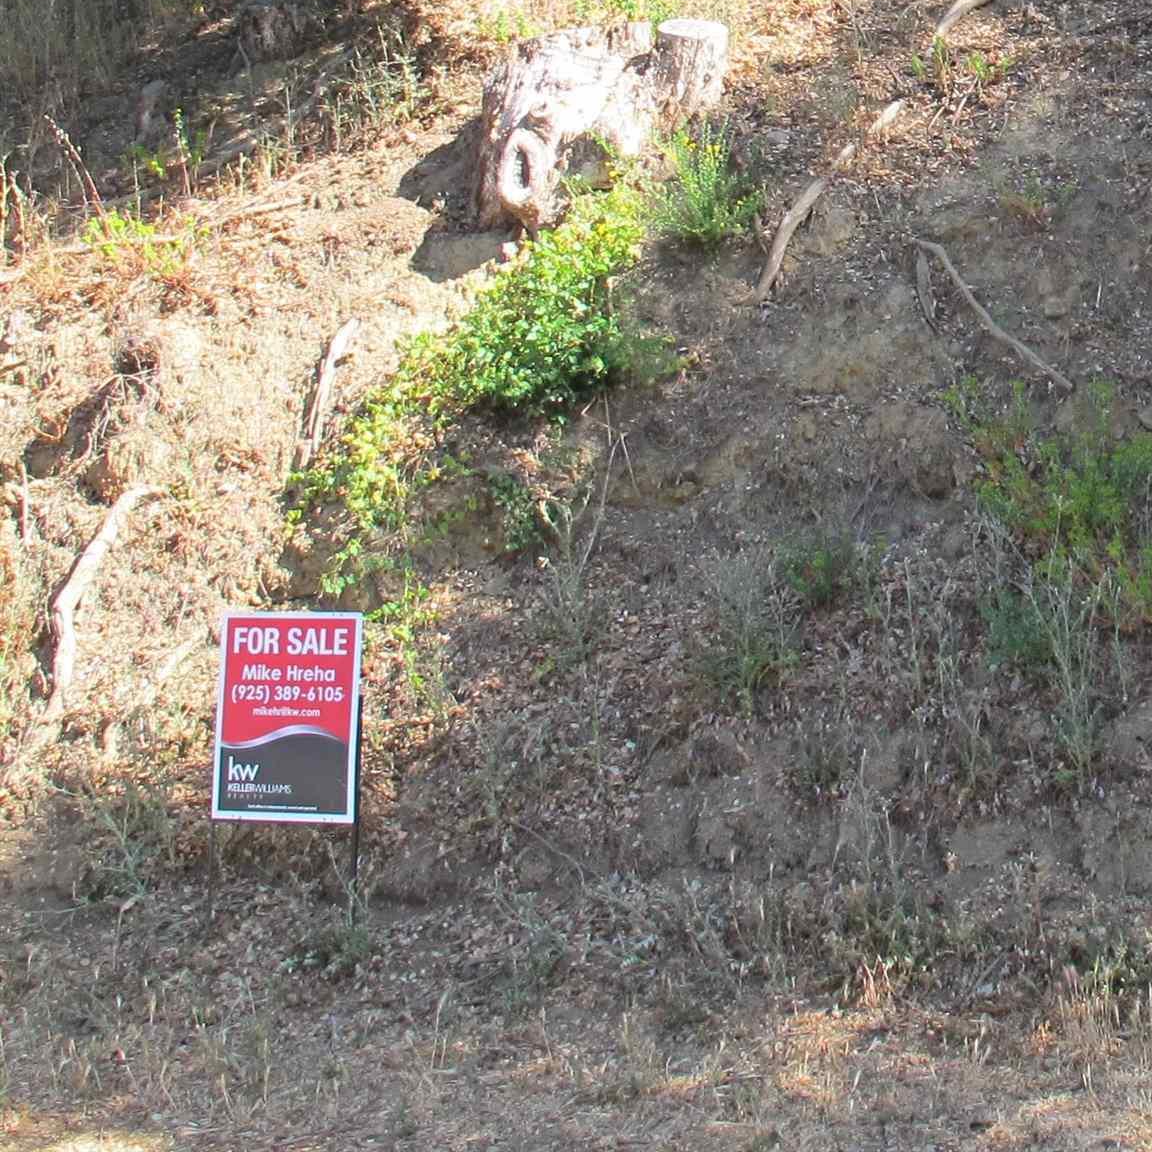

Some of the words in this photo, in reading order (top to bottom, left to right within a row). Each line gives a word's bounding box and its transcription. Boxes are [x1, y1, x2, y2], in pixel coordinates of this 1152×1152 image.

[233, 627, 280, 654] FOR
[288, 628, 348, 656] SALE
[242, 664, 281, 680] Mike
[287, 665, 335, 681] Hreha
[232, 685, 269, 703] (925)
[274, 686, 343, 702] 389-6105
[228, 756, 259, 781] kw
